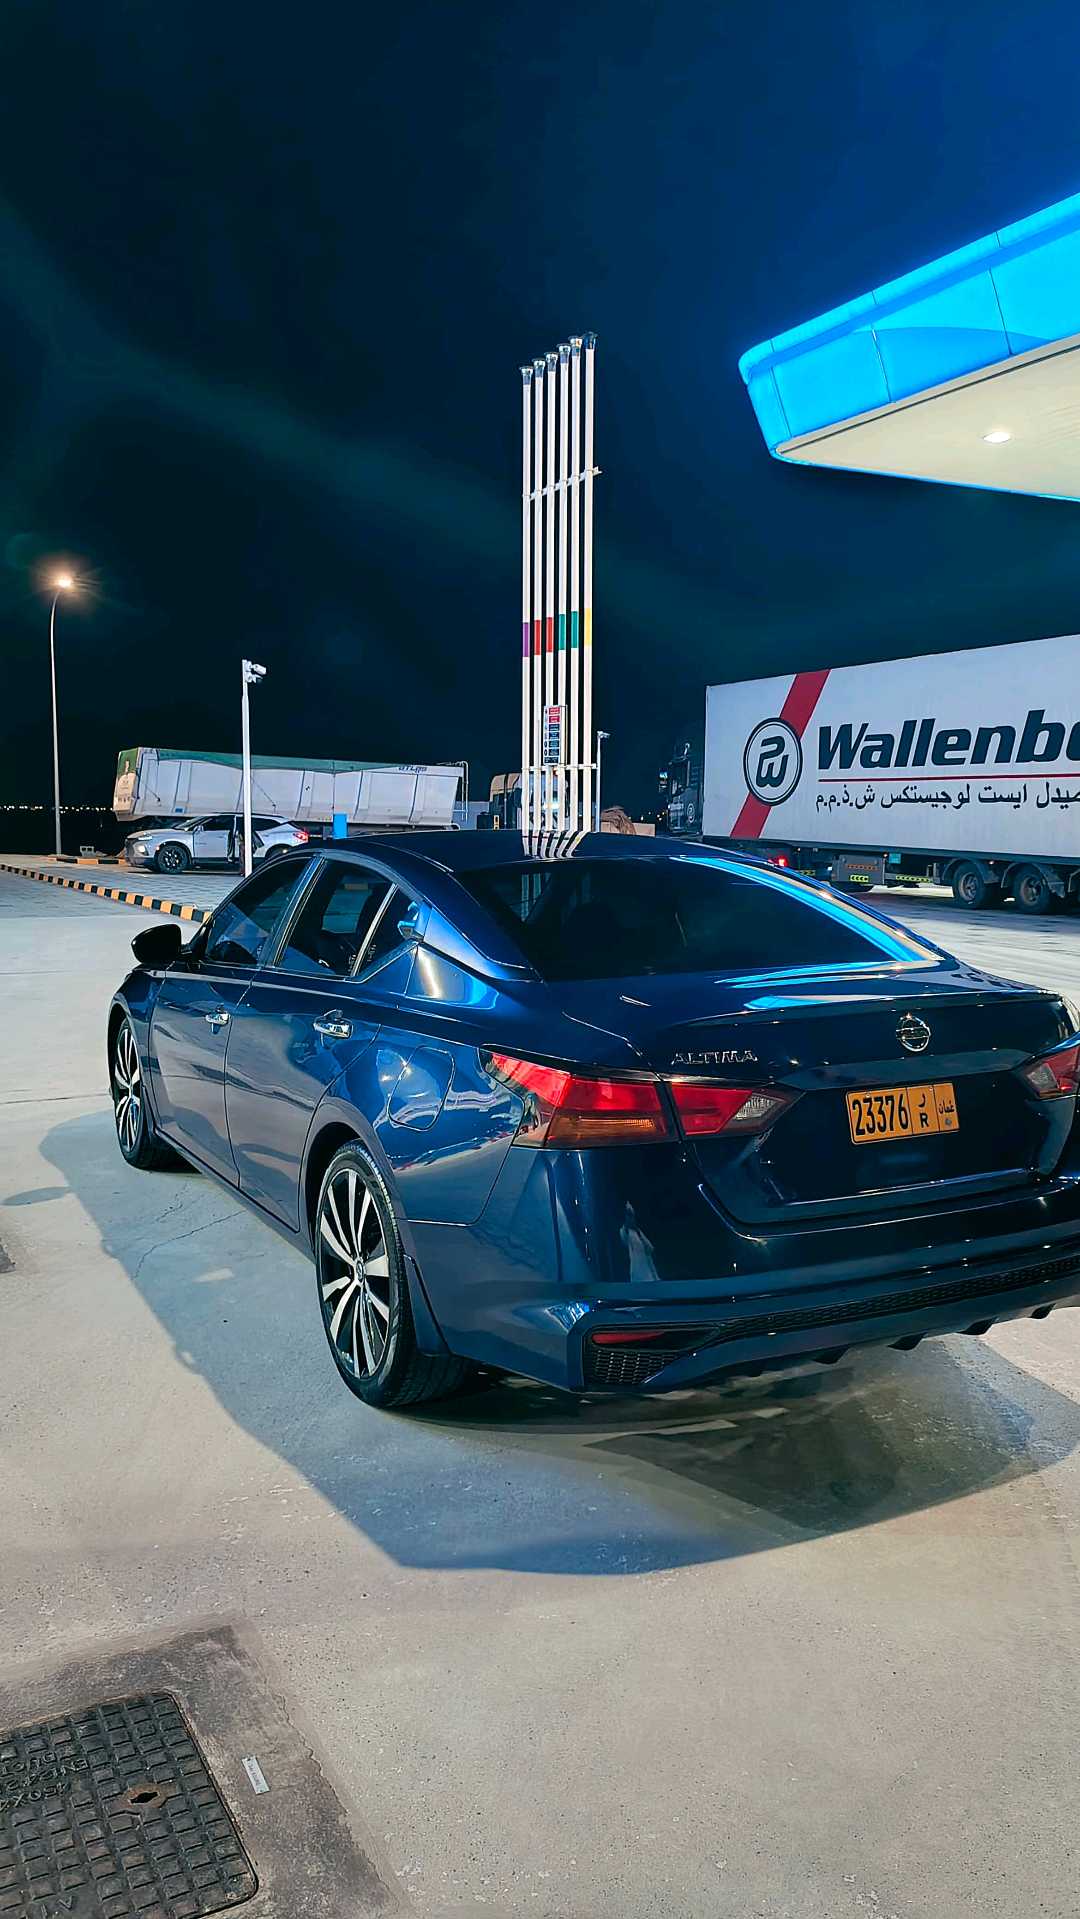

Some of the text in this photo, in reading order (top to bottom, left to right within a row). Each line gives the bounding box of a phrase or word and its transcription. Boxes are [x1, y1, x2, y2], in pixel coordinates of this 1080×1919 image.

[671, 1050, 758, 1065] ALTIMA
[852, 1094, 909, 1136] 23376
[920, 1112, 929, 1128] R
